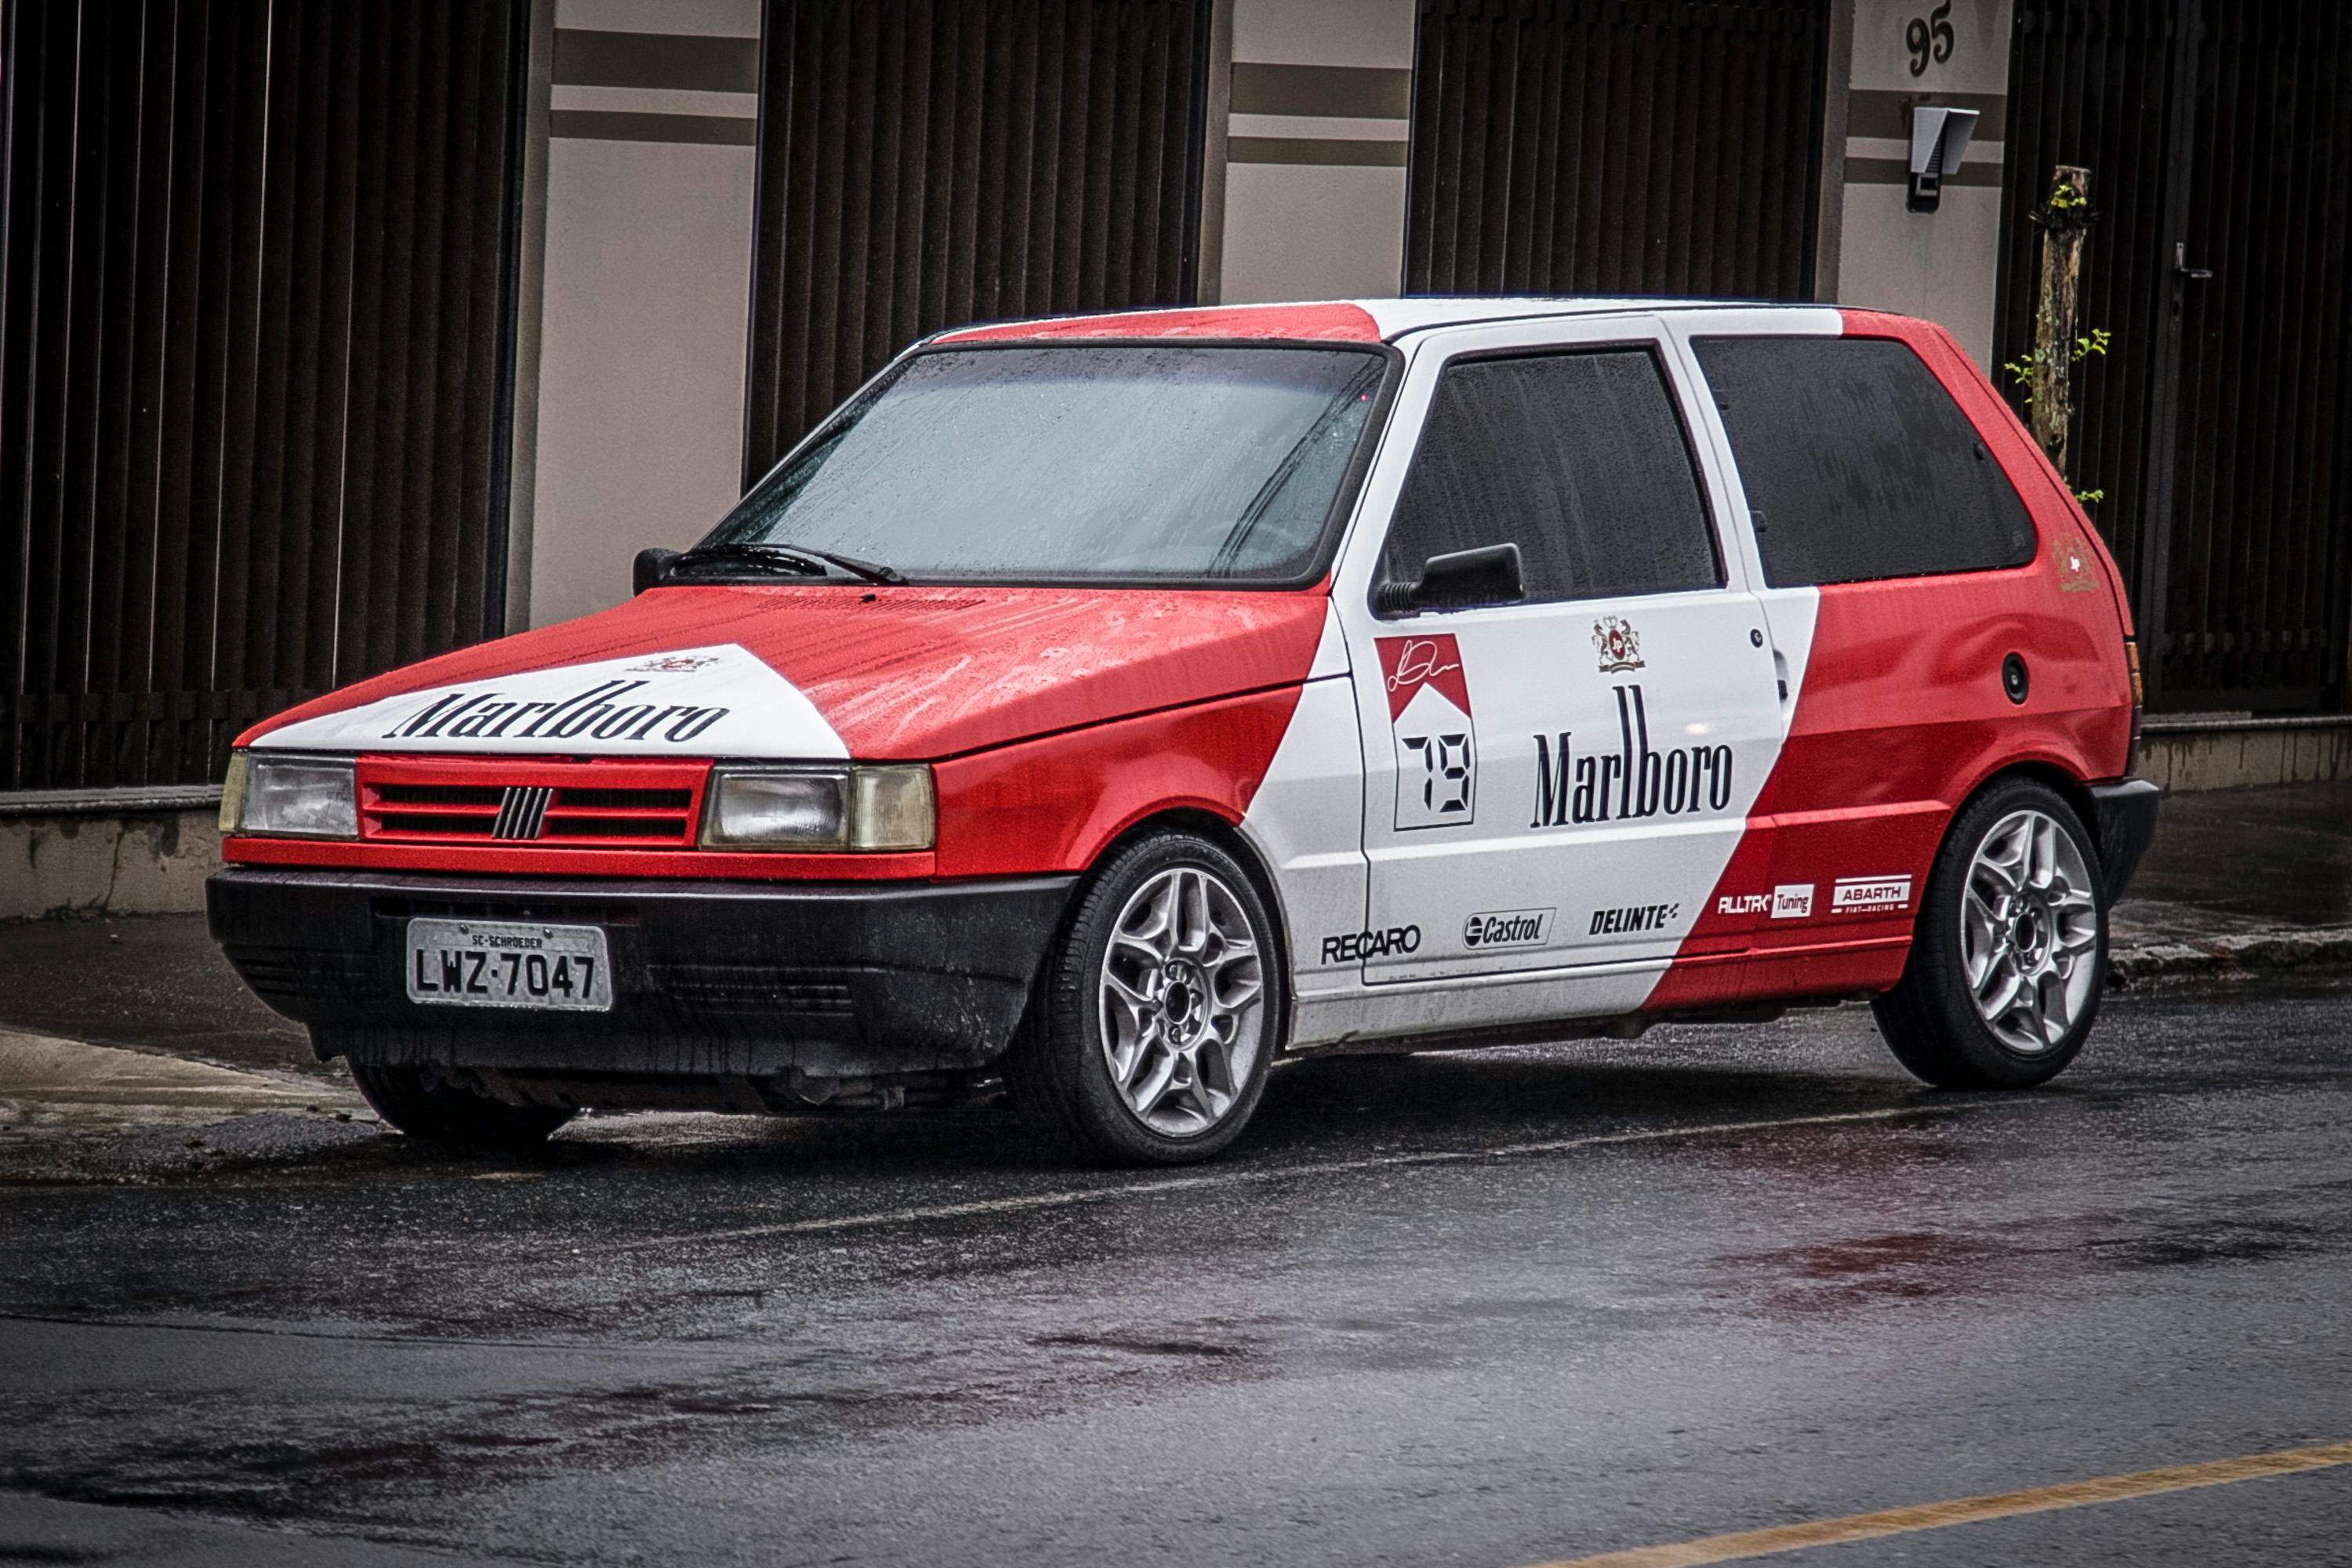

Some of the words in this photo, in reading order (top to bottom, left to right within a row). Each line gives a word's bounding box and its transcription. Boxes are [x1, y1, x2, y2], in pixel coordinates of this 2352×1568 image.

[1906, 0, 1955, 78] 95
[381, 679, 730, 742] Marlboro
[1401, 733, 1470, 813] 79
[1530, 684, 1733, 828] Marlboro
[1777, 893, 1809, 913] Tuning
[1842, 885, 1901, 902] ABARTH
[1482, 913, 1544, 944] Castrol
[1588, 904, 1669, 935] DELINTE
[1320, 924, 1421, 965] RECARO
